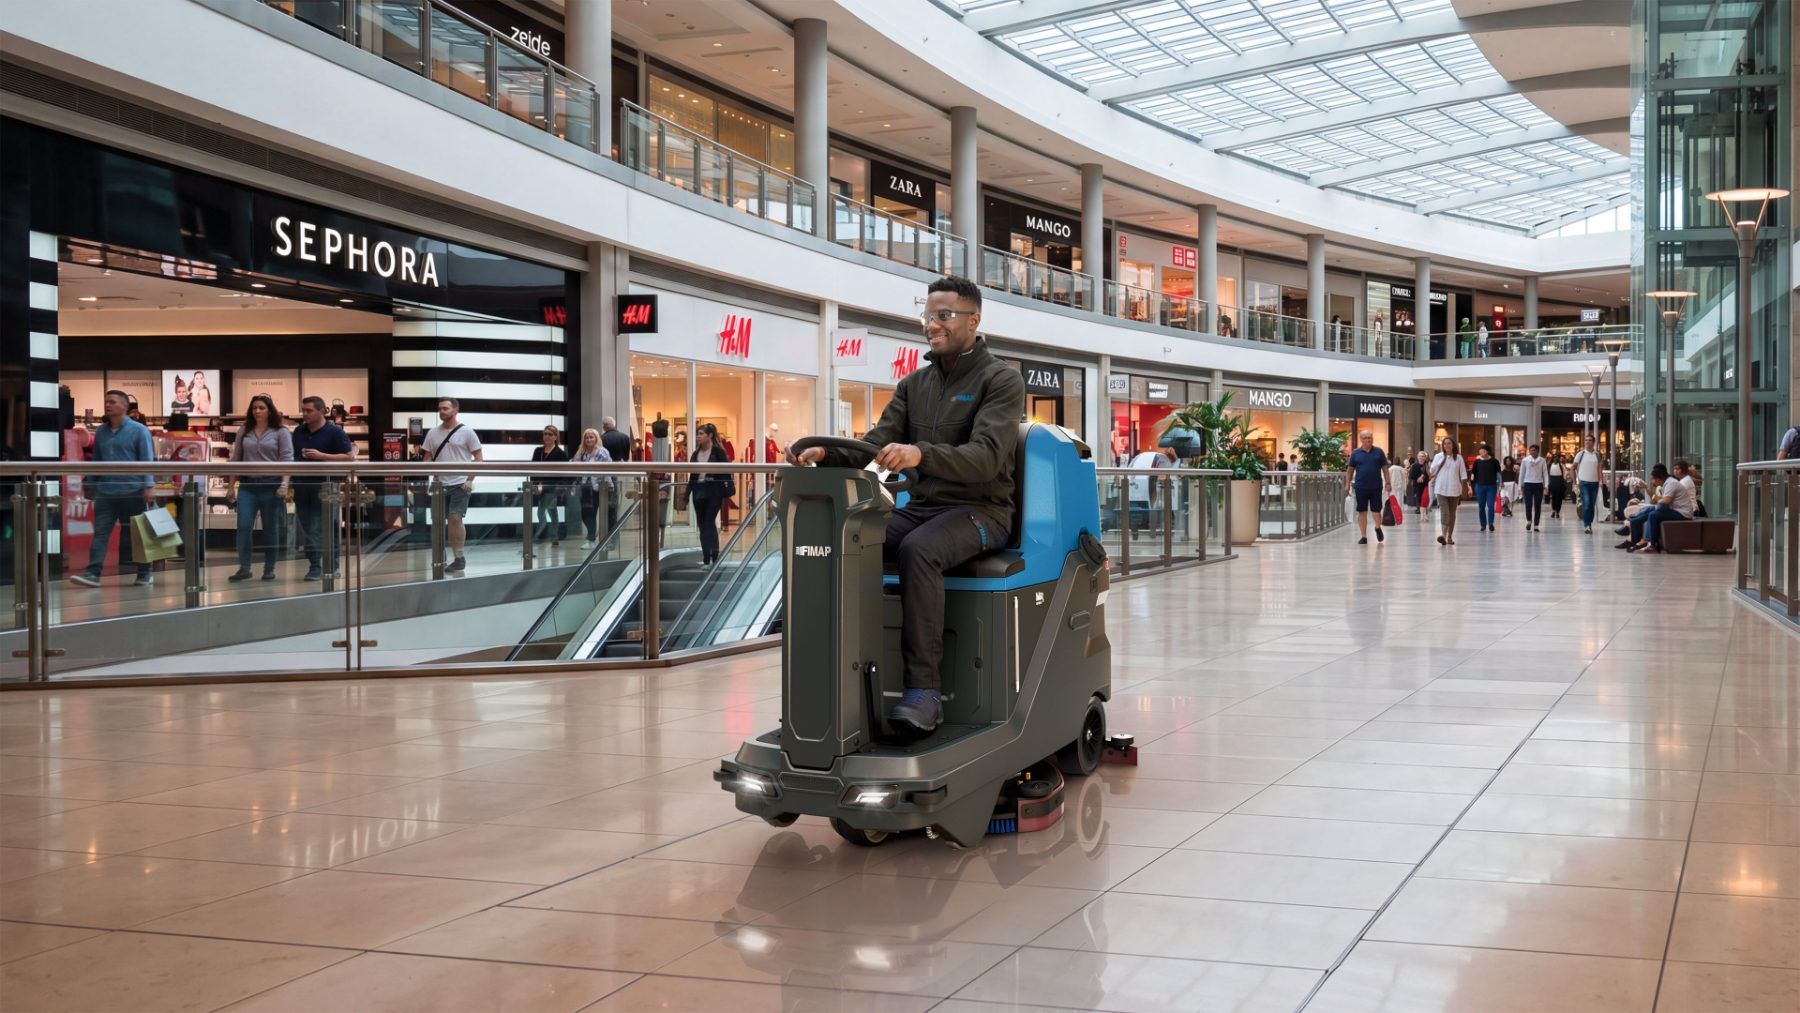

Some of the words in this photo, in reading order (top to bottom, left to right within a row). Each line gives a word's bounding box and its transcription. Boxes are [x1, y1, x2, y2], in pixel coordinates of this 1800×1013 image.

[511, 26, 551, 56] zeide
[889, 175, 922, 198] ZARA
[1026, 215, 1071, 238] MANGO
[275, 216, 439, 288] SEPHORA
[623, 304, 650, 325] H&M
[719, 314, 752, 358] H&M
[836, 338, 862, 357] H&M
[893, 346, 919, 379] H&M
[1027, 369, 1060, 389] ZARA
[1249, 390, 1292, 408] MANGO
[1360, 403, 1392, 414] MANGO
[803, 545, 832, 557] FIMAP
